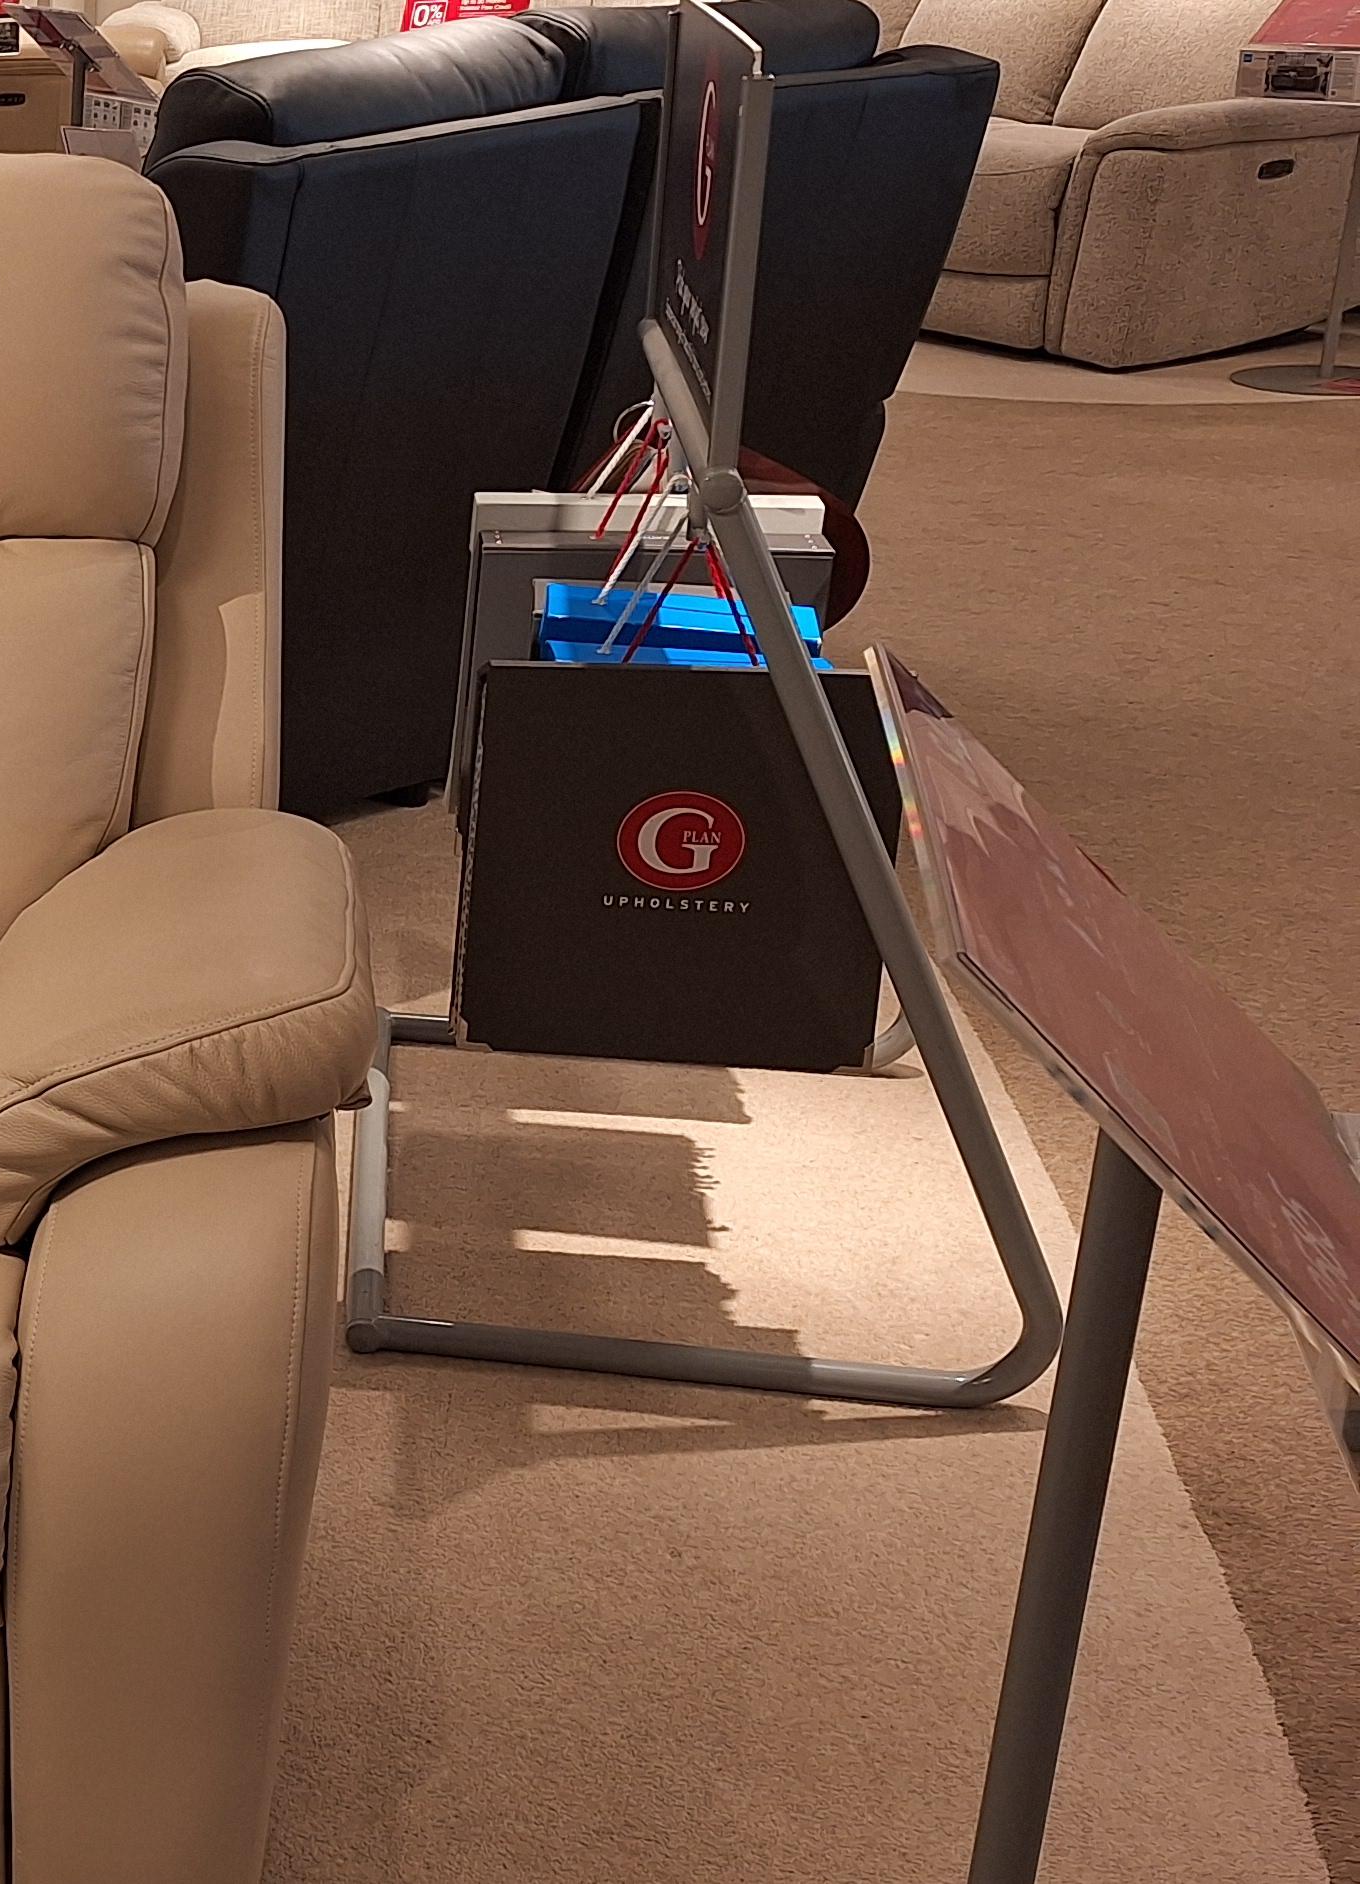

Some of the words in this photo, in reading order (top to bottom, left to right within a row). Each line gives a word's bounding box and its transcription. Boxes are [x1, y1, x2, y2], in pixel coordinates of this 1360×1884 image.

[413, 4, 443, 27] 0%
[637, 807, 719, 874] G
[682, 830, 722, 844] PLAN
[603, 895, 750, 913] UPHOLSTERY
